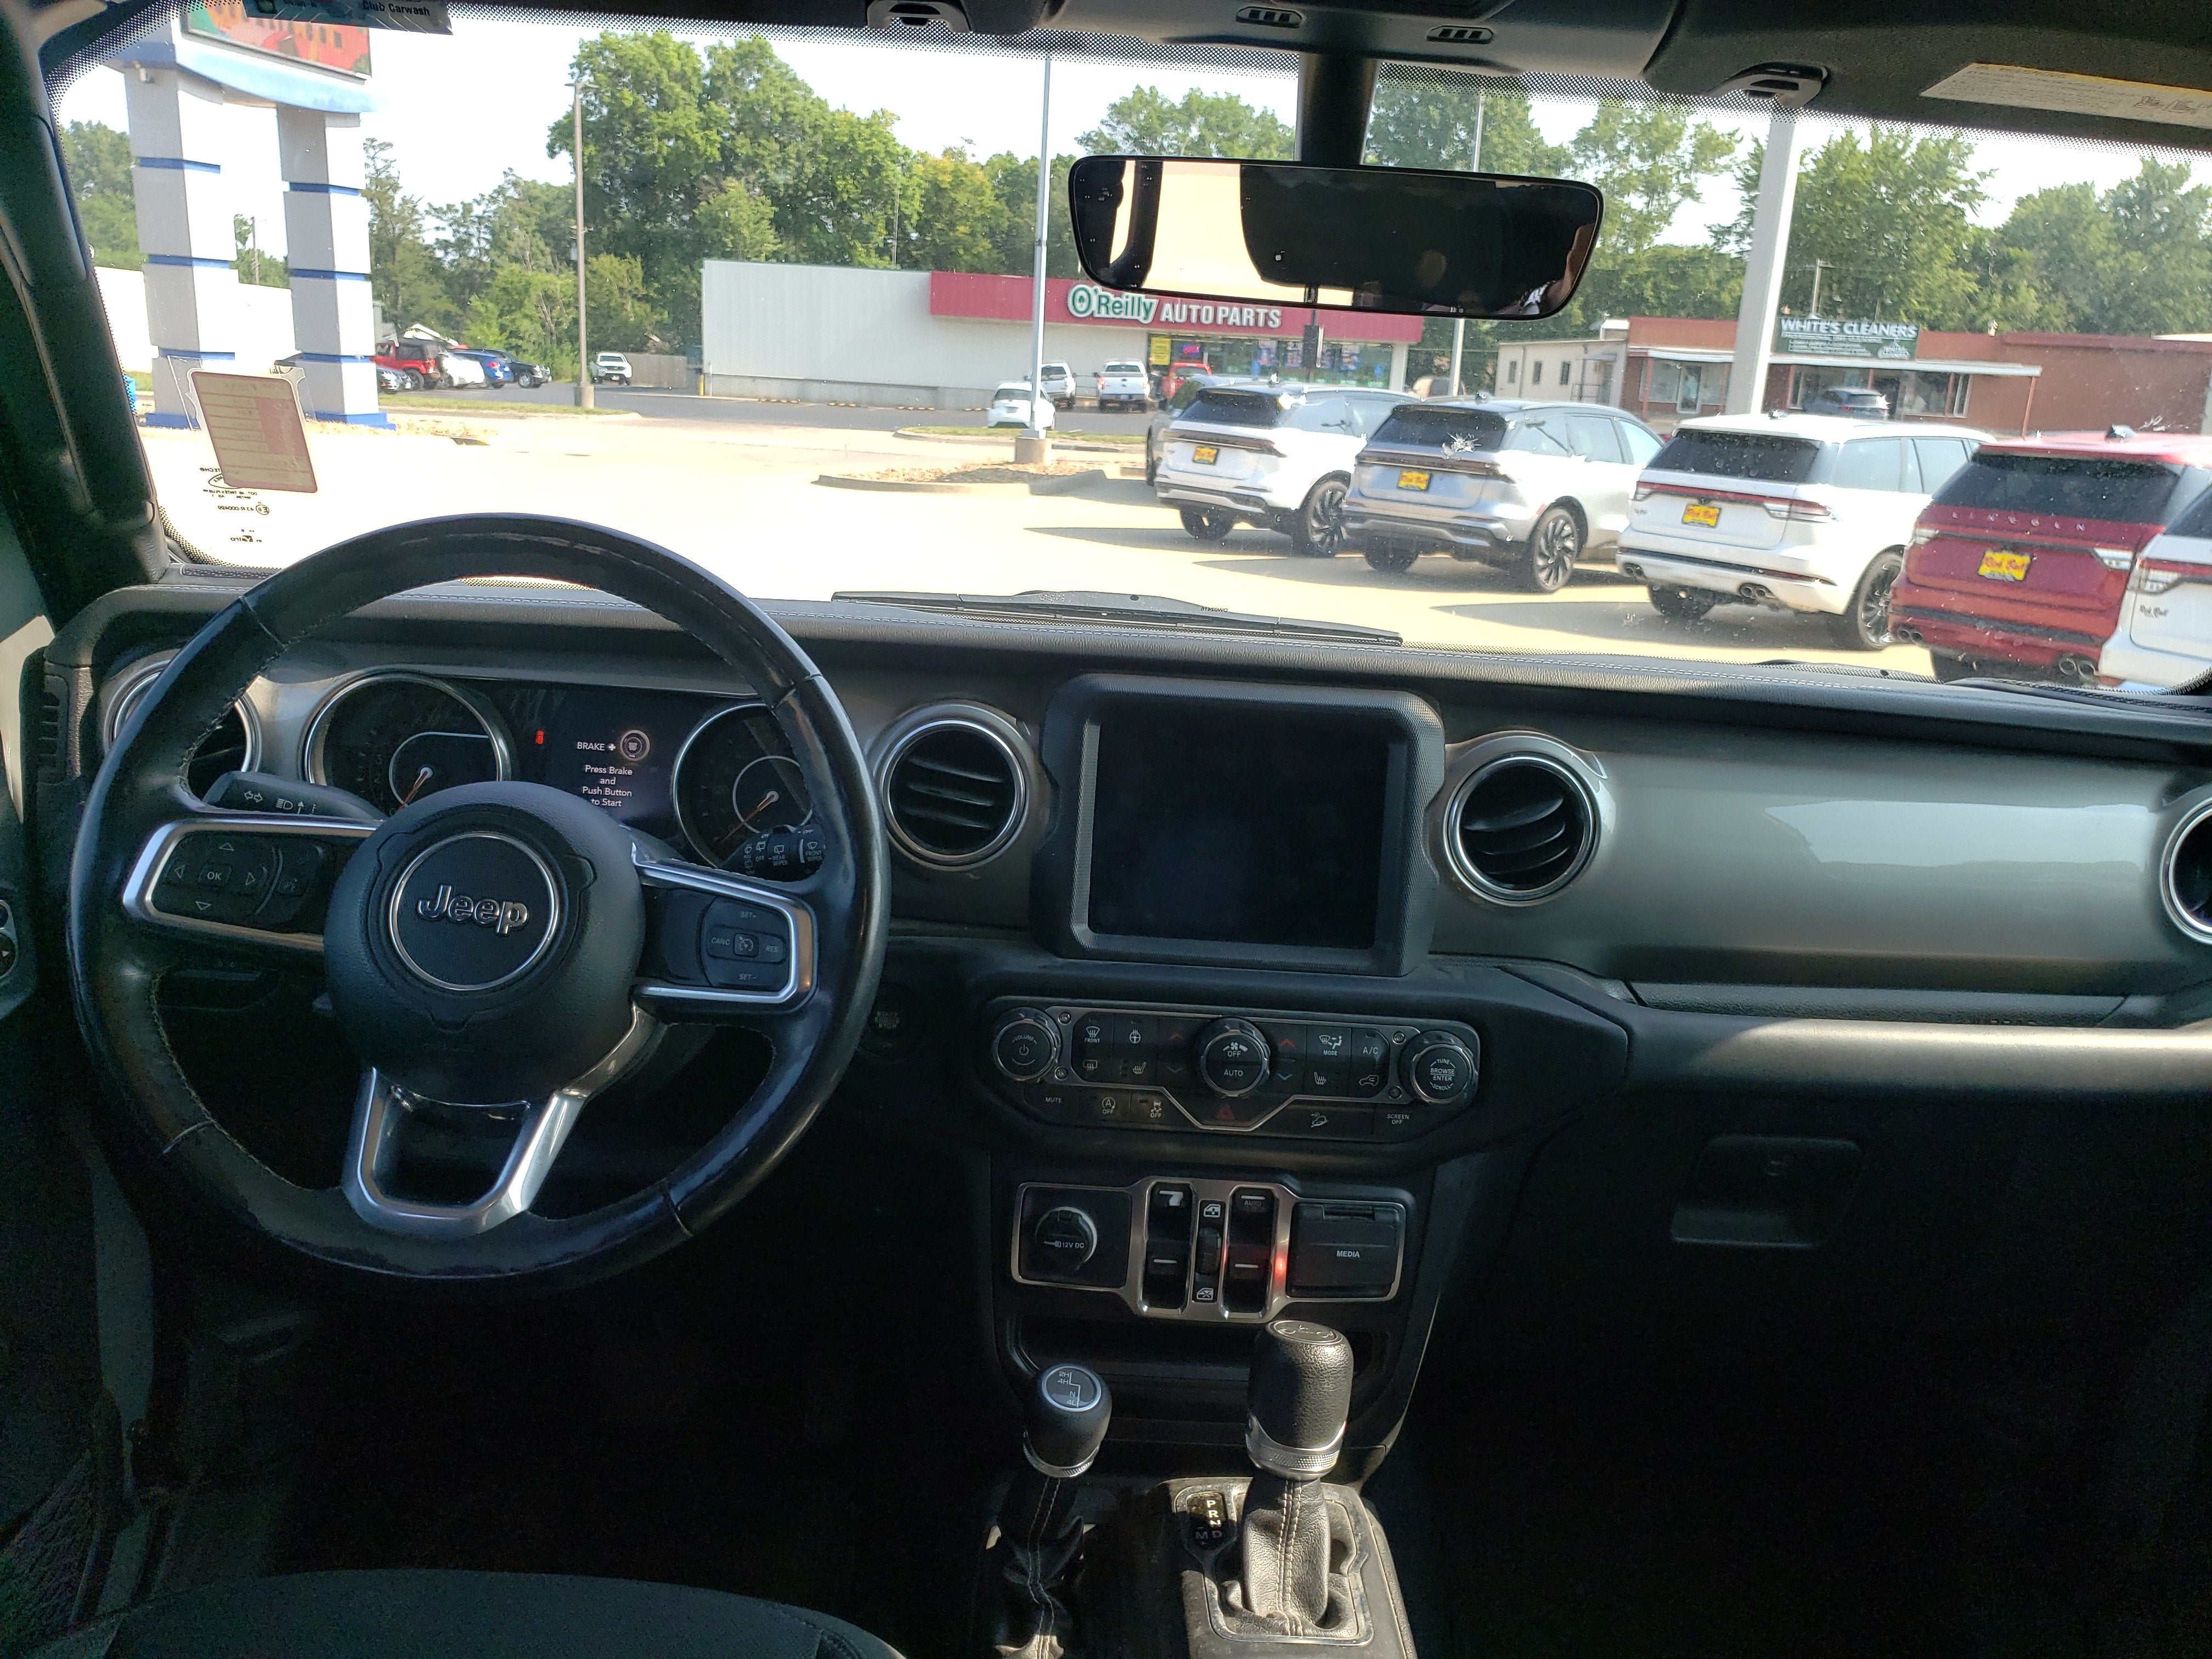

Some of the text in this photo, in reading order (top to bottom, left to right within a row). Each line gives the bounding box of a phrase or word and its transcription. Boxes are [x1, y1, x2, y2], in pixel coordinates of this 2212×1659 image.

[362, 1, 430, 16] Club Carwash
[1069, 286, 1283, 328] O'Reilly AUTO PARTS
[1781, 319, 1842, 334] WHITE'S
[1843, 321, 1918, 338] CLEANERS
[1952, 511, 2085, 532] LINCOLN
[577, 742, 605, 751] BRAKE
[585, 764, 633, 775] Press Brake
[600, 777, 617, 785] and
[583, 786, 632, 797] Push Button
[602, 798, 622, 807] Start
[207, 872, 222, 880] OK
[417, 884, 528, 935] Jeep
[711, 936, 730, 945] CANC
[1363, 1046, 1379, 1054] A/C
[1336, 1250, 1360, 1258] MEDIA
[1069, 1390, 1076, 1398] N
[1206, 1499, 1217, 1508] P
[1208, 1509, 1219, 1519] R
[1210, 1519, 1222, 1528] N
[1195, 1530, 1223, 1539] M D
